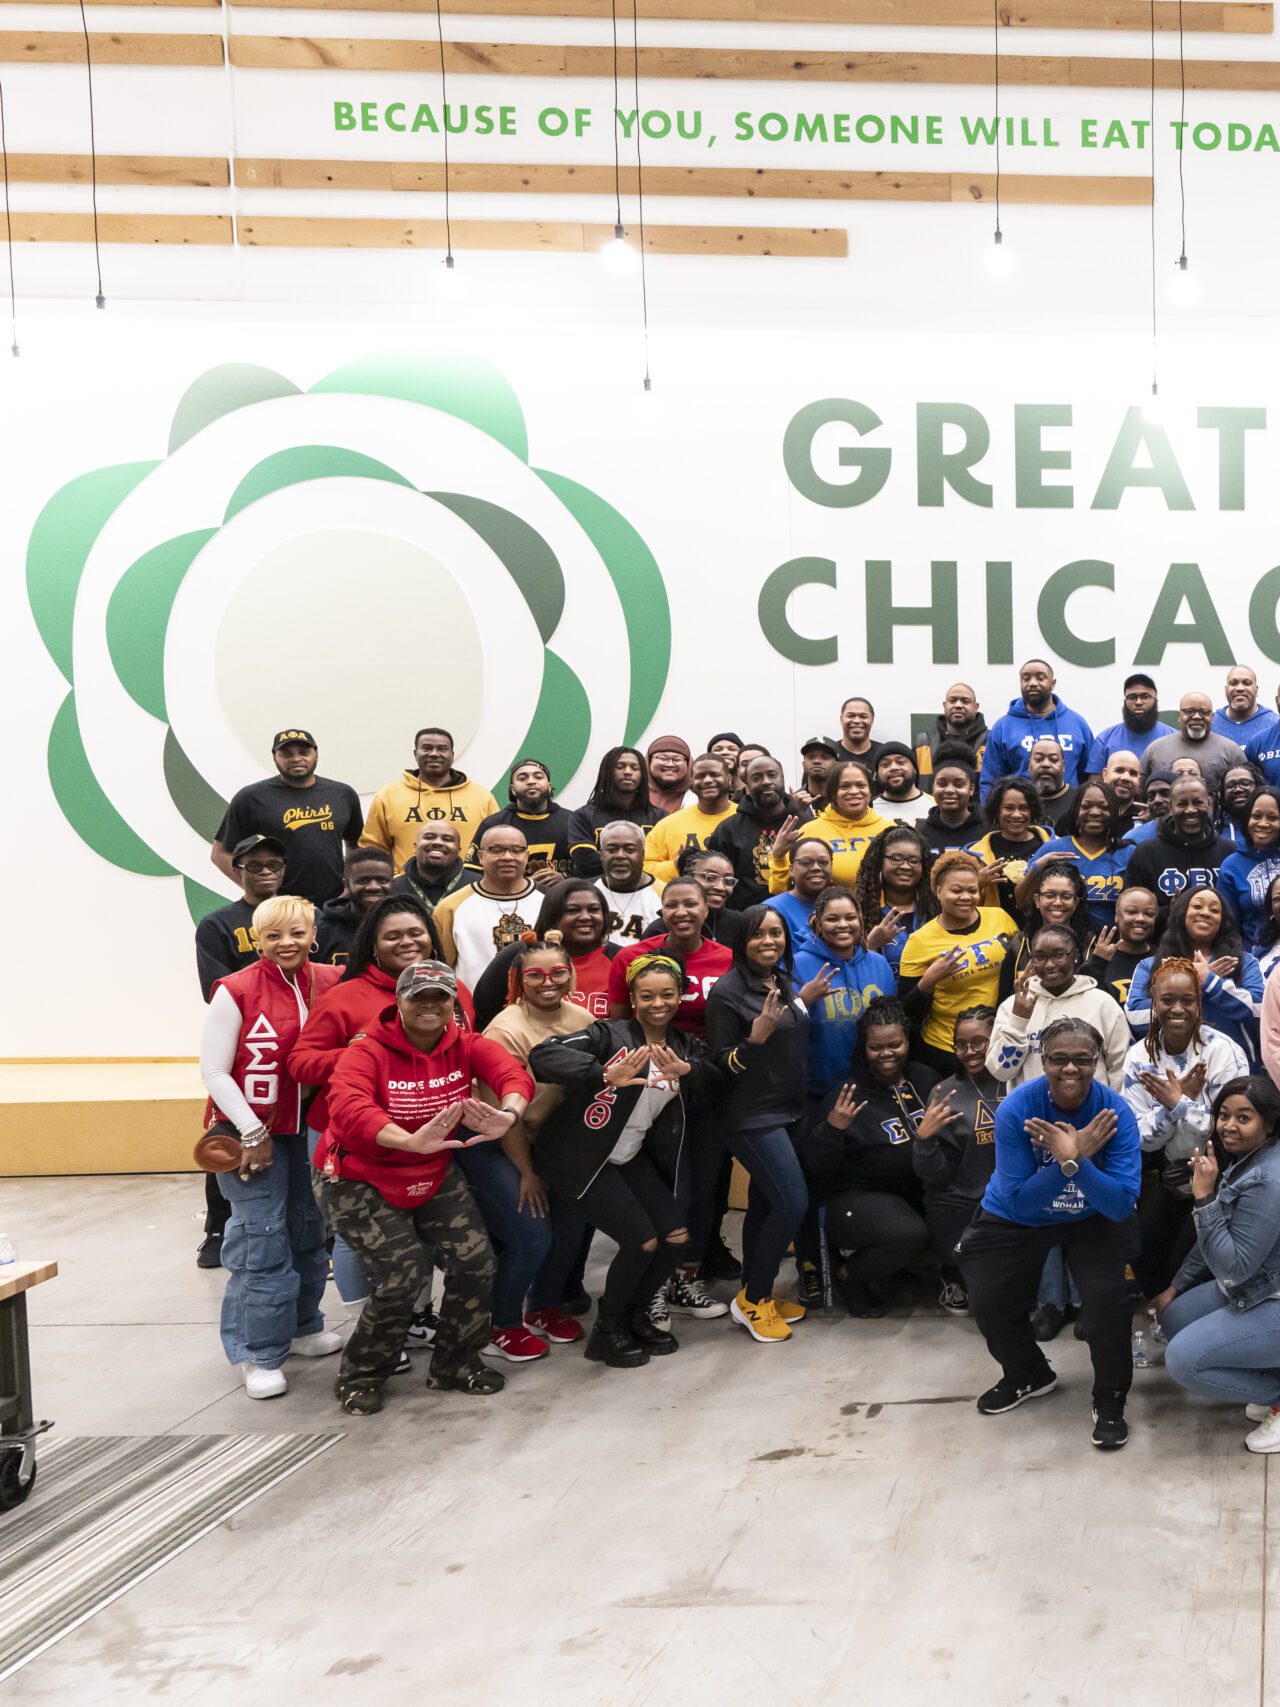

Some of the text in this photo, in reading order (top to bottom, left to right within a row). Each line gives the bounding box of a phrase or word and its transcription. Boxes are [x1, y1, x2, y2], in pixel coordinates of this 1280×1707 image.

[333, 101, 517, 136] BECAUSE
[537, 107, 592, 137] OF
[614, 108, 718, 148] YOU,
[734, 111, 943, 145] SOMEONE
[959, 115, 1060, 148] WILL
[1081, 118, 1151, 150] EAT
[283, 804, 333, 824] Phirst
[320, 821, 335, 831] 06
